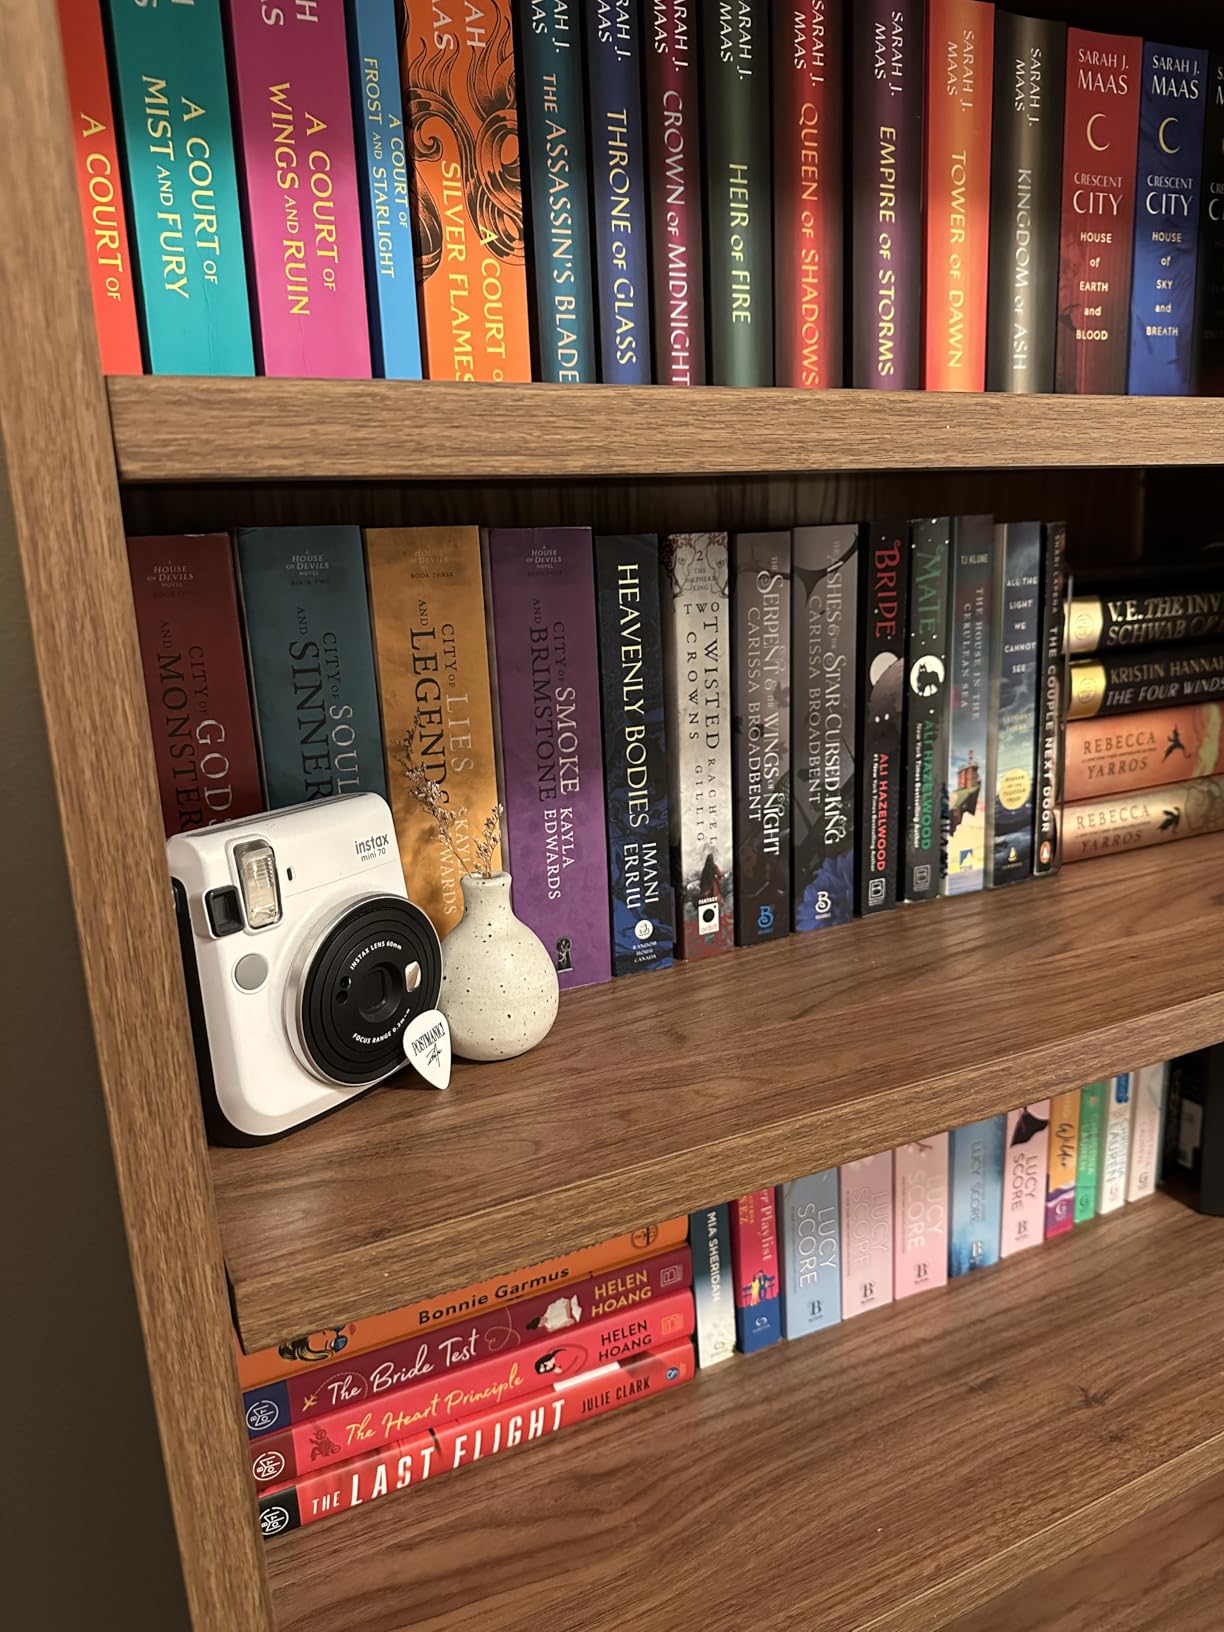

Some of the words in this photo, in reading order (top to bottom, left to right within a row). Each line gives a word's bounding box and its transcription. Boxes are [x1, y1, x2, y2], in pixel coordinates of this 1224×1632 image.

[719, 2, 733, 62] MAAS
[794, 11, 806, 69] MAAS
[812, 0, 824, 66] SARAH
[874, 22, 886, 79] MAAS
[891, 11, 903, 76] SARAH
[1078, 48, 1119, 68] SARAH
[364, 57, 382, 124] FROST
[947, 41, 958, 96] MAAS
[962, 29, 975, 95] SARAH
[1015, 59, 1025, 112] MAAS
[1029, 47, 1042, 109] SARAH
[1078, 69, 1128, 95] MAAS
[1151, 76, 1199, 100] MAAS
[1152, 55, 1189, 73] SARAH
[142, 75, 175, 161] MIST
[181, 96, 206, 122] A
[543, 73, 558, 113] THE
[80, 112, 106, 137] A
[268, 82, 299, 190] WINGS
[304, 112, 328, 136] A
[373, 131, 382, 160] AND
[663, 90, 685, 206] CROWN
[800, 103, 819, 201] QUEEN
[157, 165, 173, 206] AND
[186, 137, 220, 255] COURT
[390, 138, 408, 207] COURT
[607, 109, 631, 234] THRONE
[729, 163, 748, 228] HEIR
[880, 126, 896, 224] EMPIRE
[950, 149, 967, 244] TOWER
[1074, 171, 1123, 189] CRESCENT
[1147, 174, 1193, 190] CRESCENT
[86, 153, 123, 272] COURT
[285, 195, 298, 234] AND
[308, 150, 338, 263] COURT
[373, 168, 394, 278] STARLIGHT
[442, 162, 466, 262] SILVER
[545, 119, 575, 284] ASSASSIN'S
[1015, 168, 1032, 289] KINGDOM
[1072, 190, 1124, 217] CITY
[1145, 191, 1193, 217] CITY
[157, 212, 189, 299] FURY
[612, 241, 626, 271] OF
[1080, 232, 1113, 244] HOUSE
[1152, 231, 1182, 243] HOUSE
[283, 240, 310, 315] RUIN
[731, 270, 751, 324] FIRE
[1079, 281, 1109, 293] EARTH
[1156, 279, 1173, 290] SKY
[449, 273, 474, 382] FLAMES
[481, 257, 505, 359] COURT
[613, 277, 636, 365] GLASS
[668, 243, 690, 386] MIDNIGHT
[802, 249, 819, 386] SHADOWS
[879, 270, 894, 376] STORMS
[949, 291, 964, 368] DAWN
[1076, 329, 1109, 341] BLOOD
[1084, 305, 1102, 317] and
[1146, 325, 1179, 337] BREATH
[1155, 302, 1172, 314] and
[555, 295, 579, 383] BLADE
[1013, 324, 1028, 371] ASH
[531, 549, 557, 557] HOUSE
[1022, 576, 1037, 585] THE
[418, 600, 428, 626] AND
[533, 600, 542, 624] AND
[684, 602, 719, 614] TWO
[875, 539, 900, 638] BRIDE
[915, 545, 944, 635] MATE
[1010, 600, 1033, 610] LIGHT
[1108, 600, 1144, 621] V.E.
[1144, 597, 1183, 619] THE
[296, 606, 308, 635] AND
[441, 623, 456, 672] CITY
[553, 621, 567, 667] CITY
[618, 564, 645, 715] HEAVENLY
[756, 571, 784, 674] SERPENT
[809, 595, 822, 679] CARISSA
[1004, 642, 1036, 654] CANNOT
[1049, 627, 1059, 657] THE
[1107, 620, 1185, 646] SCHWAB
[189, 646, 208, 697] CITY
[322, 632, 341, 683] CITY
[748, 607, 761, 693] CARISSA
[1111, 664, 1164, 683] KRISTIN
[686, 632, 699, 740] CROWNS
[703, 616, 720, 749] TWISTED
[1045, 665, 1057, 731] COUPLE
[1106, 688, 1134, 706] THE
[1138, 682, 1179, 701] FOUR
[446, 694, 473, 773] LIES
[529, 626, 557, 802] BRIMSTONE
[555, 687, 579, 795] SMOKE
[822, 652, 847, 791] STAR-CURSED
[923, 720, 933, 744] ALI
[1083, 731, 1157, 754] REBECCA
[748, 702, 761, 821] BROADBENT
[764, 712, 779, 778] WINGS
[808, 688, 822, 803] BROADBENT
[880, 754, 888, 776] ALI
[1043, 738, 1056, 778] NEXT
[1087, 756, 1148, 780] YARROS
[625, 726, 649, 828] BODIES
[695, 765, 705, 842] GILLIG
[707, 758, 718, 844] RACHEL
[921, 750, 933, 849] HAZELWOOD
[764, 793, 784, 855] NIGHT
[825, 796, 847, 845] KING
[877, 781, 888, 871] HAZELWOOD
[1041, 785, 1055, 832] DOOR
[1076, 805, 1150, 829] REBECCA
[354, 833, 390, 855] instax
[361, 850, 377, 862] mini
[544, 810, 561, 900] EDWARDS
[561, 807, 574, 868] KAYLA
[1081, 830, 1142, 852] YARROS
[624, 843, 640, 909] ERRIU
[643, 843, 659, 904] IMANI
[350, 948, 370, 970] INSTAX
[370, 941, 385, 951] LENS
[387, 941, 402, 950] 60mm
[634, 954, 656, 962] CANADA
[352, 1033, 371, 1044] FOCUS
[372, 1031, 392, 1043] RANGE
[971, 1142, 982, 1175] LUCY
[1011, 1153, 1024, 1211] SCORE
[1025, 1156, 1038, 1198] LUCY
[707, 1211, 717, 1238] MIA
[759, 1205, 774, 1260] Playlist
[853, 1185, 871, 1265] SCORE
[871, 1192, 889, 1250] LUCY
[908, 1170, 926, 1248] SCORE
[927, 1176, 944, 1233] LUCY
[798, 1203, 817, 1287] SCORE
[818, 1207, 837, 1267] LUCY
[418, 1292, 489, 1325] Bonnie
[495, 1267, 570, 1299] Garmus
[594, 1269, 648, 1300] HELEN
[709, 1240, 721, 1302] SHERIDAN
[592, 1286, 652, 1318] HOANG
[598, 1334, 652, 1361] HOANG
[601, 1320, 648, 1347] HELEN
[328, 1375, 362, 1405] The
[370, 1345, 434, 1393] Bride
[439, 1328, 480, 1367] Test
[346, 1416, 376, 1445] The
[381, 1397, 439, 1438] Heart
[444, 1363, 525, 1411] Principle
[312, 1491, 341, 1515] THE
[350, 1446, 435, 1507] LAST
[453, 1400, 565, 1468] FLIGHT
[582, 1393, 611, 1413] JULIE
[615, 1376, 650, 1400] CLARK
